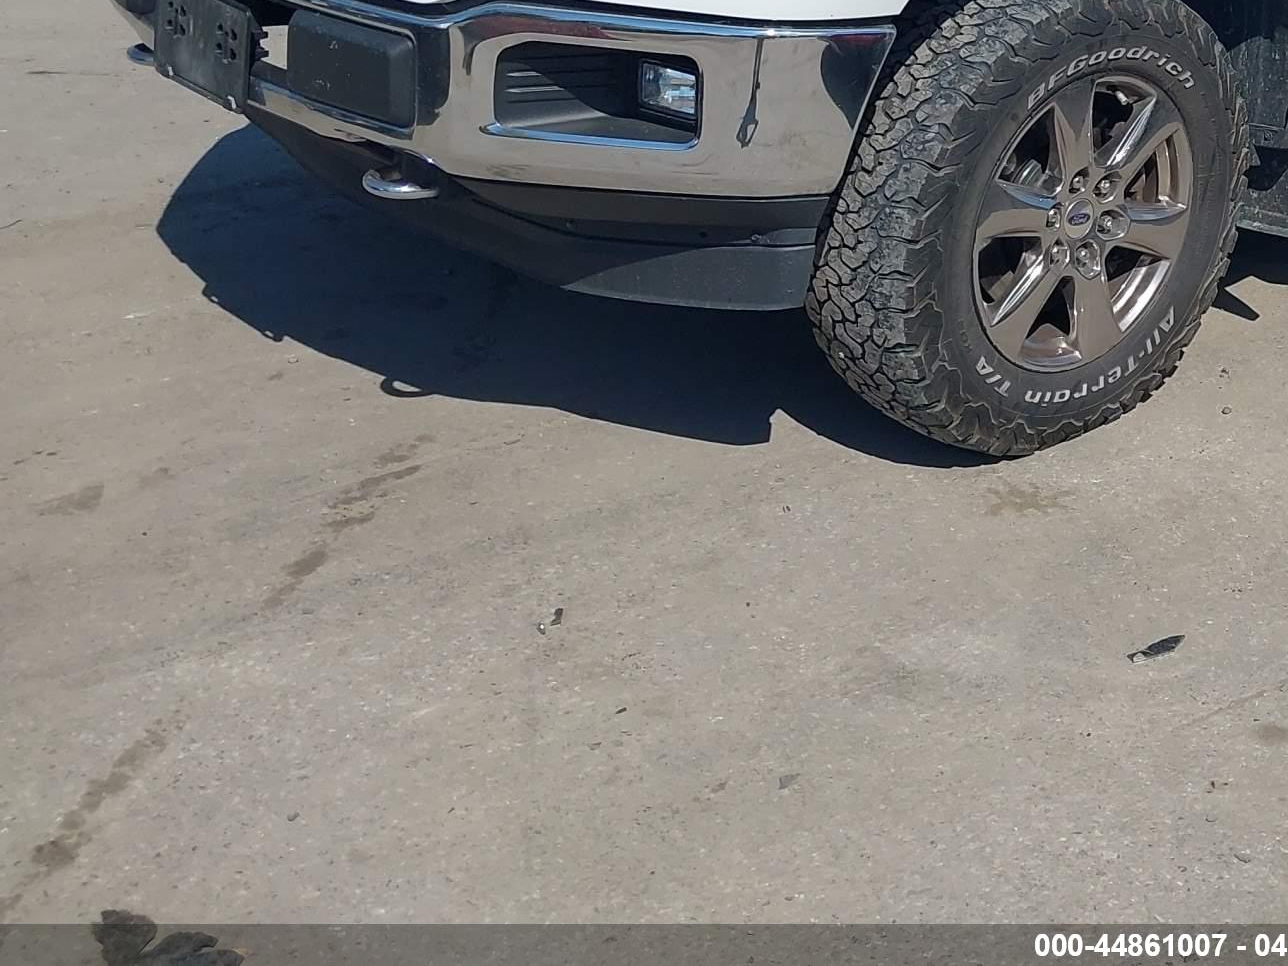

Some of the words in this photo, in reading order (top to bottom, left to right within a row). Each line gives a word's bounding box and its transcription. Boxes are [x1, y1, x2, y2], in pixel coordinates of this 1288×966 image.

[1027, 45, 1196, 110] BFGoodrich
[975, 355, 1012, 398] T/A
[1024, 305, 1176, 407] All-Terrain
